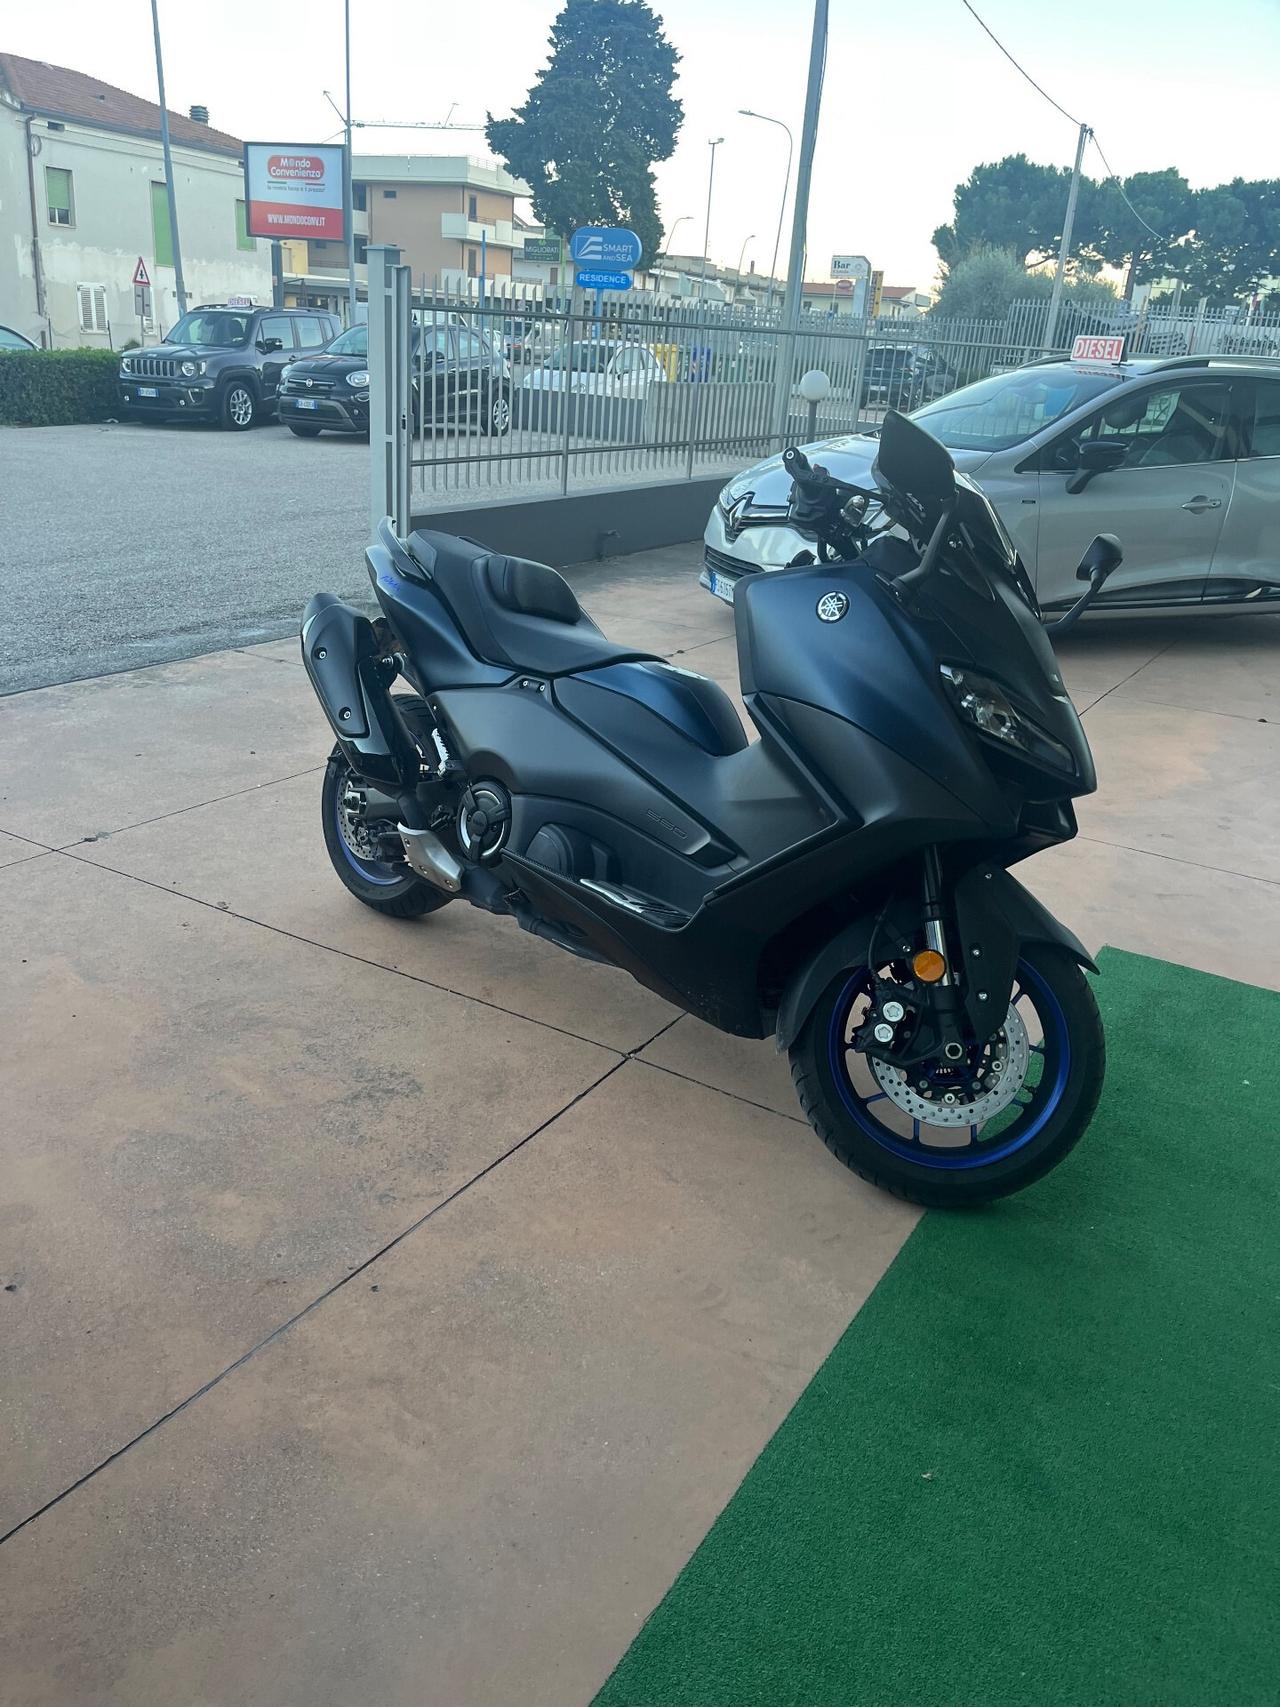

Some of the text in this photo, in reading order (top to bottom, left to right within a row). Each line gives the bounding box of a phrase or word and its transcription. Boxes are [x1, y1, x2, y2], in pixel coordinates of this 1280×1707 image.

[602, 243, 633, 254] SMART
[616, 254, 633, 262] SEA
[833, 260, 851, 269] Bar
[579, 273, 627, 284] RESIDENCE
[1073, 339, 1120, 360] DIESEL
